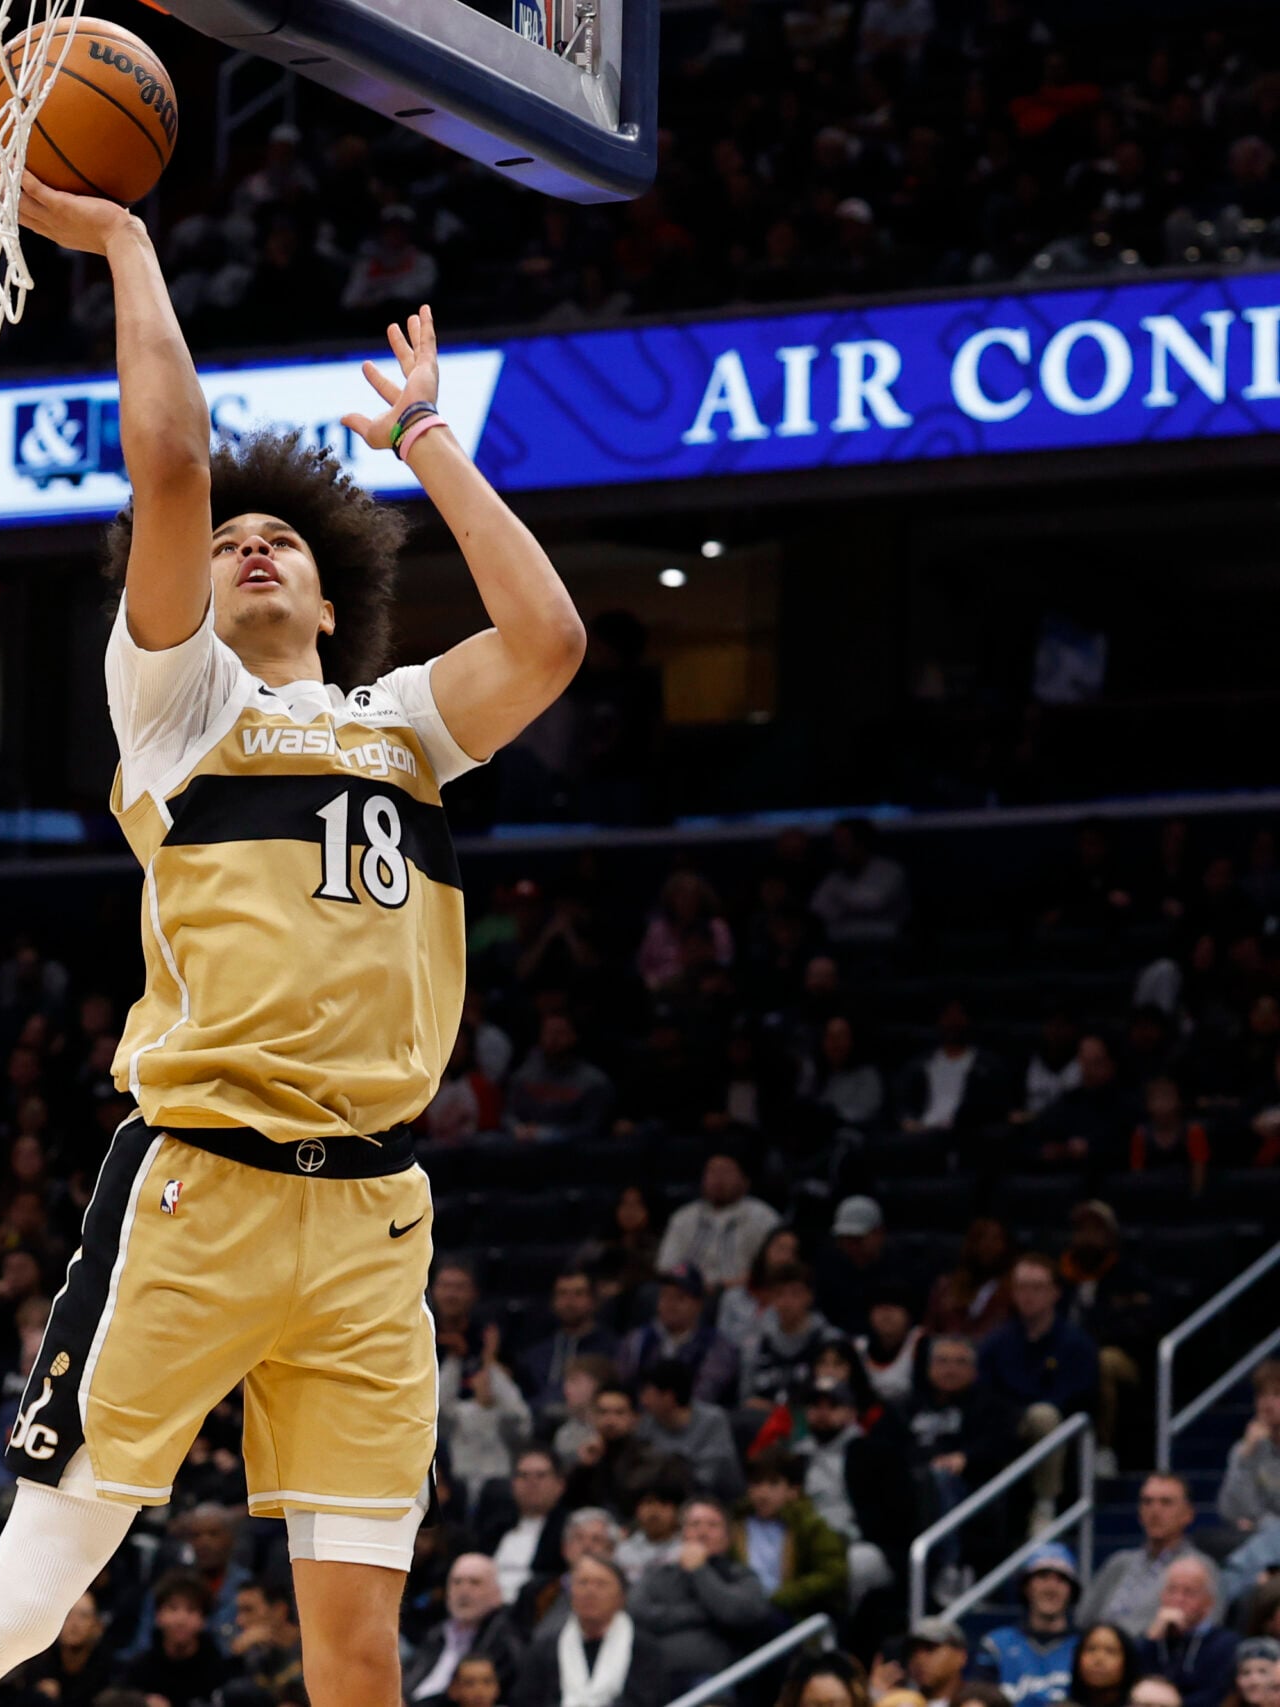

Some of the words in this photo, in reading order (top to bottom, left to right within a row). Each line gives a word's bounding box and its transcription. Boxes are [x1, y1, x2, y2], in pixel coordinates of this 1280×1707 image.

[21, 397, 84, 468] &
[680, 339, 915, 445] AIR
[312, 788, 410, 910] 18
